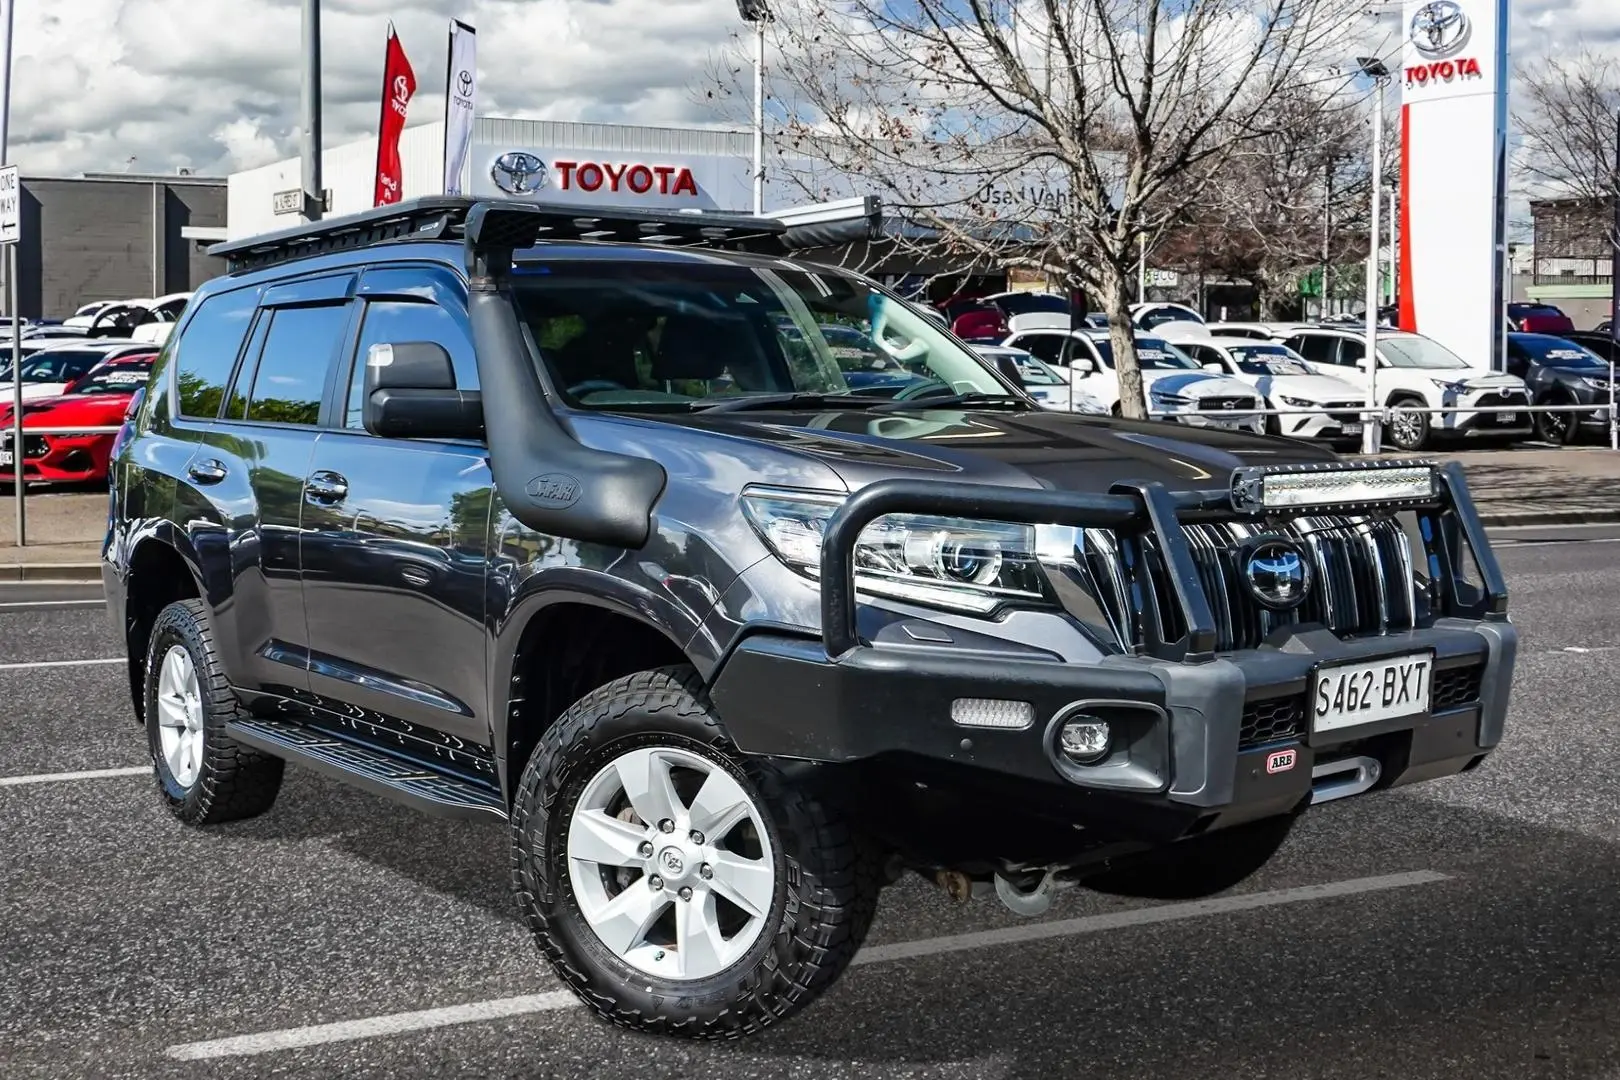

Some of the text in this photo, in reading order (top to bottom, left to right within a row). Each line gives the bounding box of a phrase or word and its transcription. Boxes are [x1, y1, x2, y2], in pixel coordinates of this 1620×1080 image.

[1404, 58, 1481, 83] TOYOTA
[1, 173, 15, 190] ONE
[555, 162, 698, 196] TOYOTA
[978, 184, 1025, 204] Used
[0, 197, 16, 213] WAY
[1272, 755, 1293, 769] ARB
